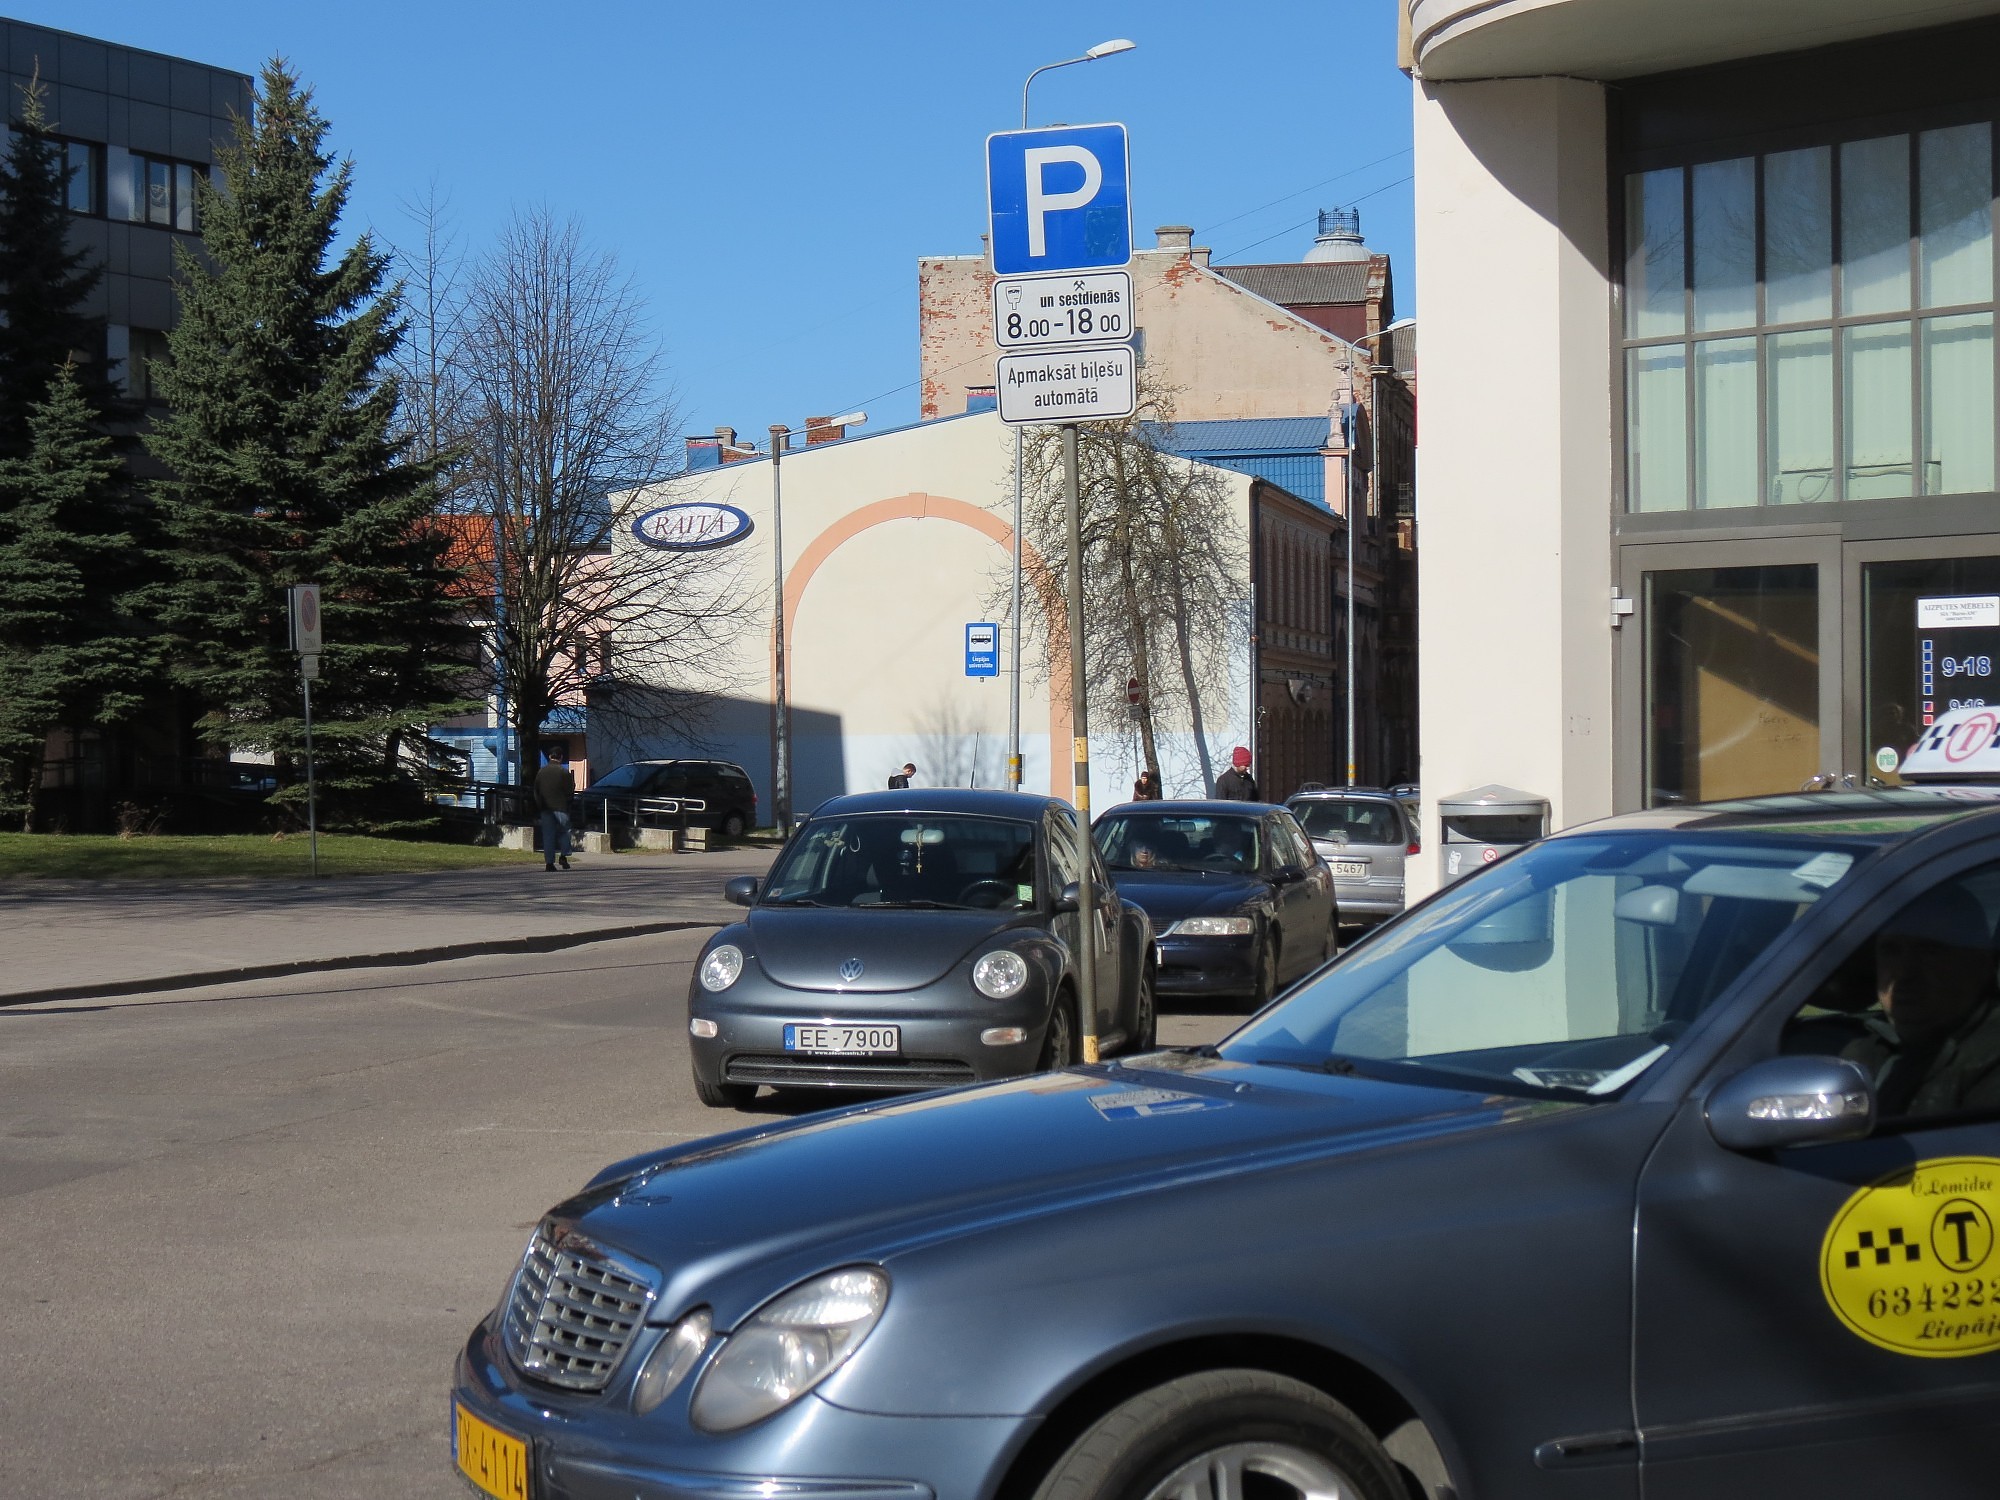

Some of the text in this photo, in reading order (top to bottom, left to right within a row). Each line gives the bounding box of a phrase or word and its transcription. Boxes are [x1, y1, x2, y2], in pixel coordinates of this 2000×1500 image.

[1025, 145, 1102, 257] P
[1040, 289, 1120, 308] un sestdienās
[1007, 360, 1123, 388] Apmaksāt biļešu
[1034, 387, 1098, 408] automātā
[654, 514, 725, 535] RAITA
[1941, 656, 1991, 677] 9-18
[1944, 1211, 1980, 1264] T
[1916, 1315, 2000, 1340] Liepāj
